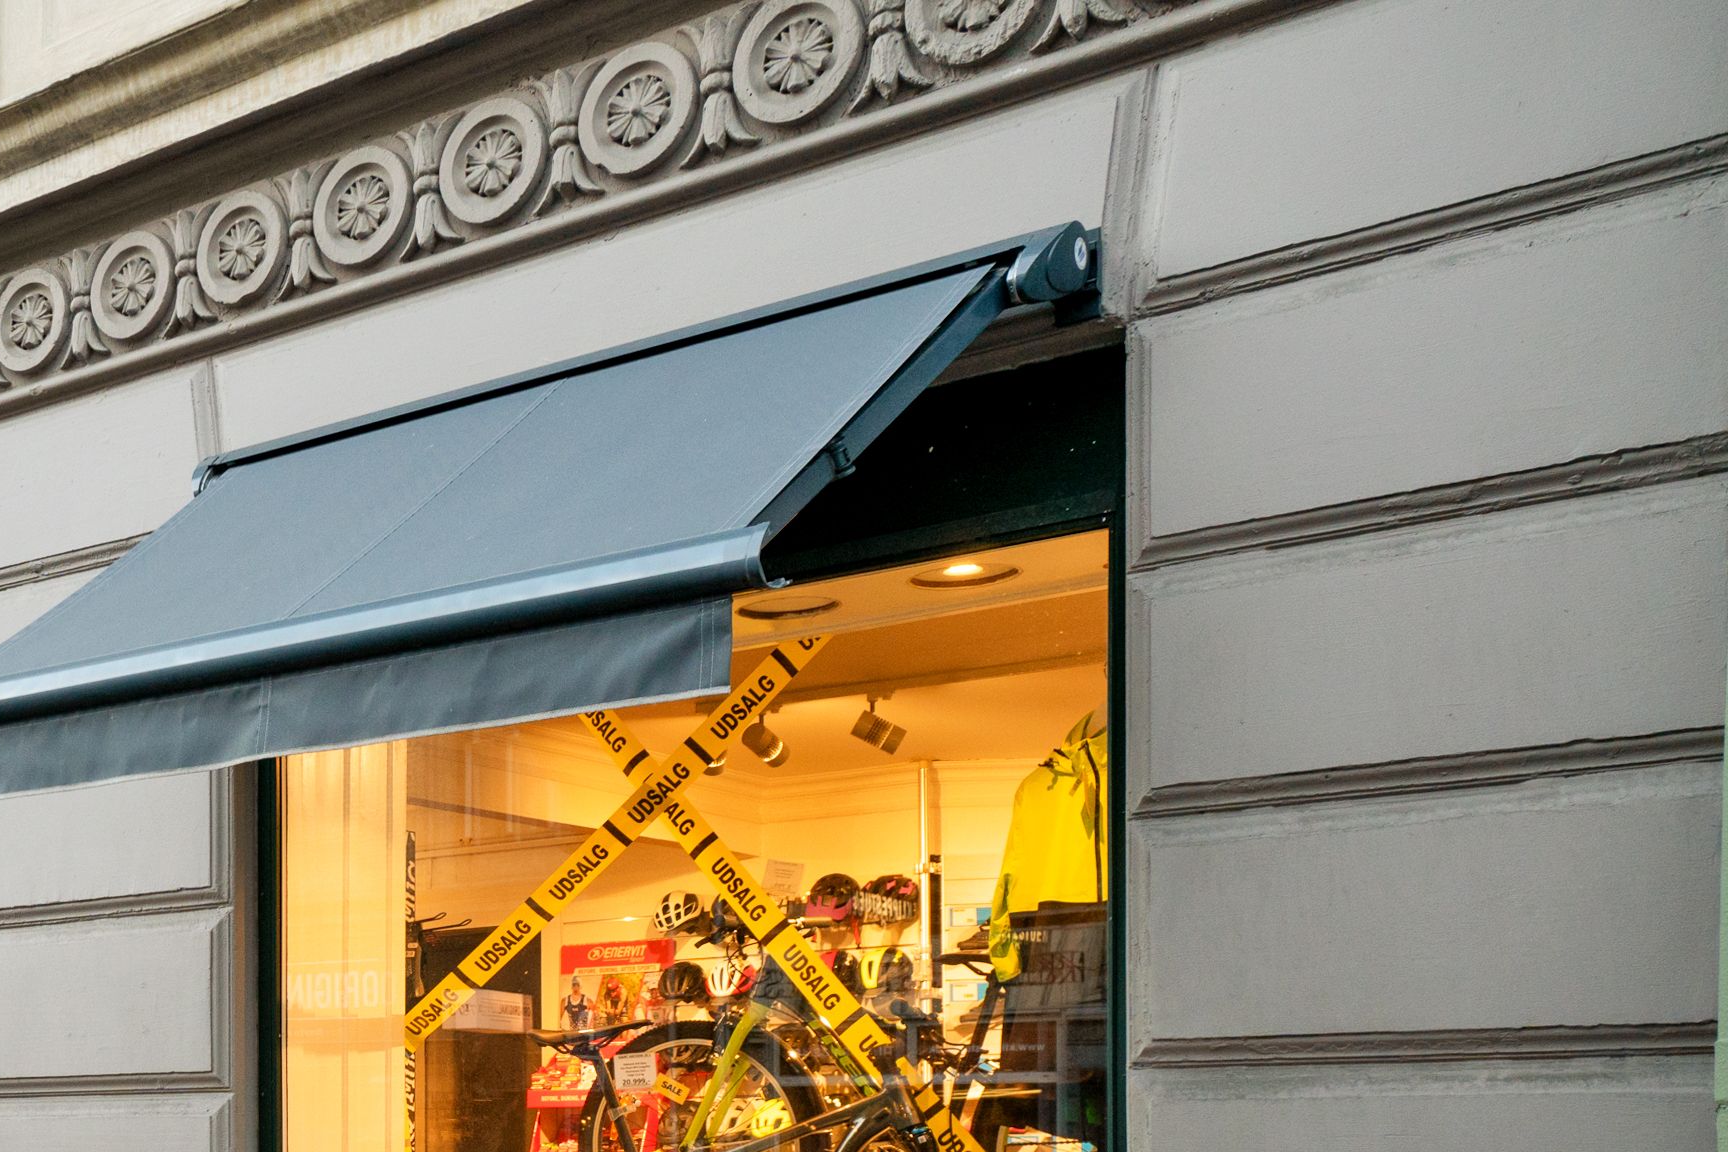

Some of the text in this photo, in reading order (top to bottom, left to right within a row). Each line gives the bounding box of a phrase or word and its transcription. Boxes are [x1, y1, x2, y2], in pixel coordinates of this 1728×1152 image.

[585, 711, 627, 753] SALG
[710, 675, 775, 740] UDSALG
[627, 762, 691, 824] UDSALG
[549, 843, 610, 901] UDSALG
[711, 857, 767, 922] UDSALG
[475, 918, 532, 973] UDSALG
[603, 945, 648, 959] ENERVIT
[783, 944, 842, 1011] UDSALG
[405, 987, 459, 1038] UDSALG
[661, 1081, 683, 1096] SALE
